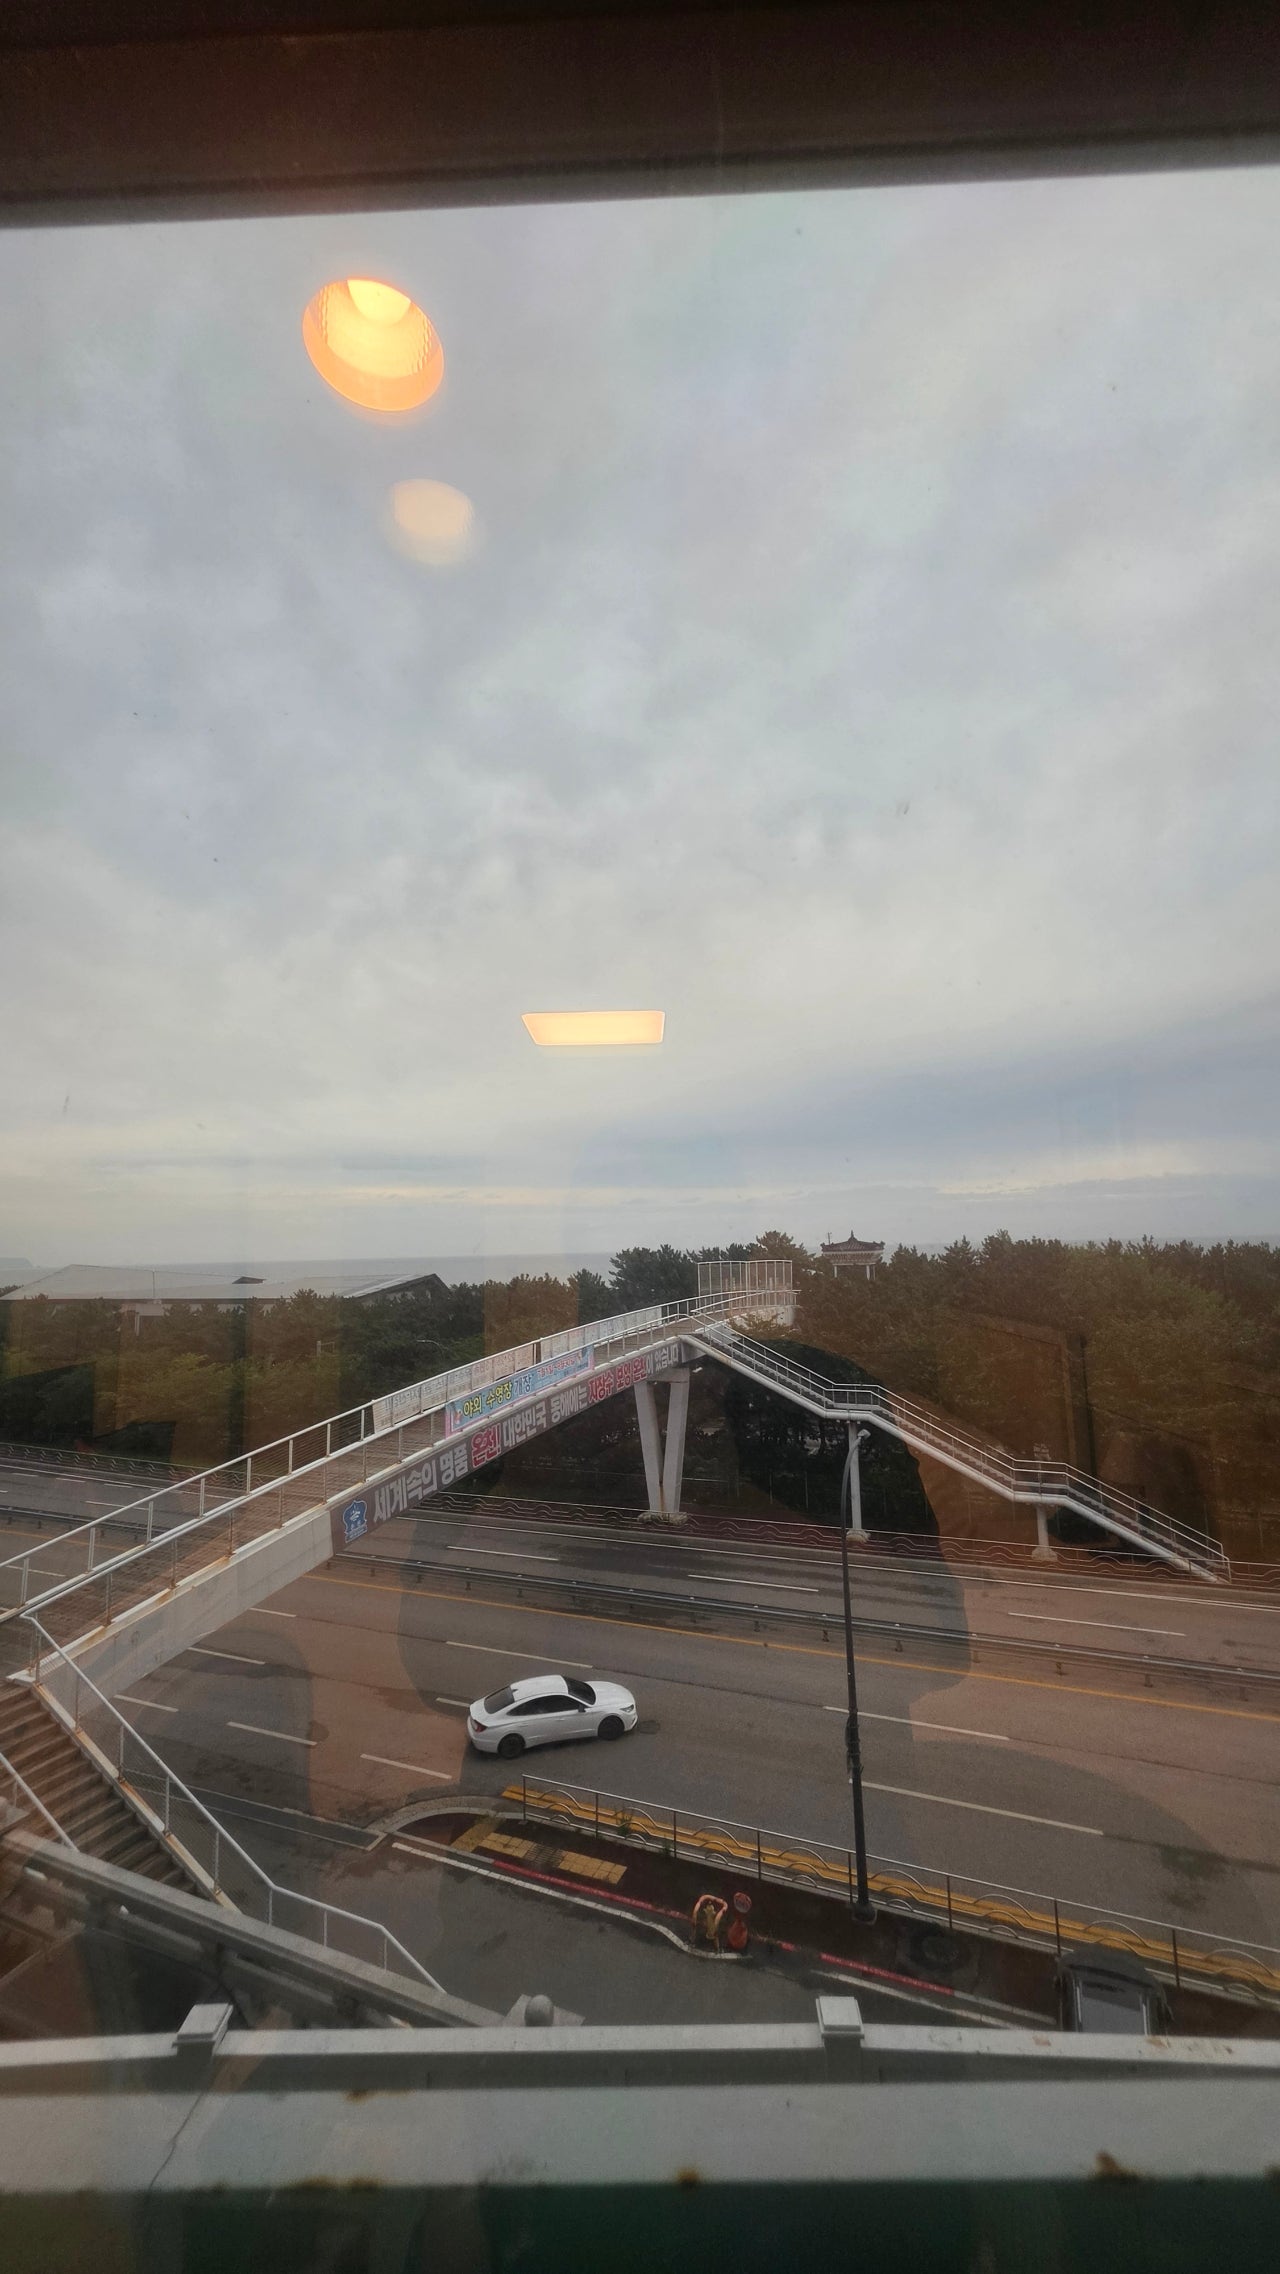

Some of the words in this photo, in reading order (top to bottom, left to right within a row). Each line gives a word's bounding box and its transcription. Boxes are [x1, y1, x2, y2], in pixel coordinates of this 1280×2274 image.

[374, 1460, 438, 1523] 세계속의
[440, 1444, 468, 1484] 명품
[472, 1425, 502, 1467] 온천!
[503, 1401, 548, 1446] 대한민국
[552, 1385, 589, 1423] 동해에는
[655, 1344, 679, 1373] 있습니다
[463, 1396, 483, 1417] 야외
[486, 1383, 513, 1406] 수영장
[515, 1374, 533, 1397] 개장
